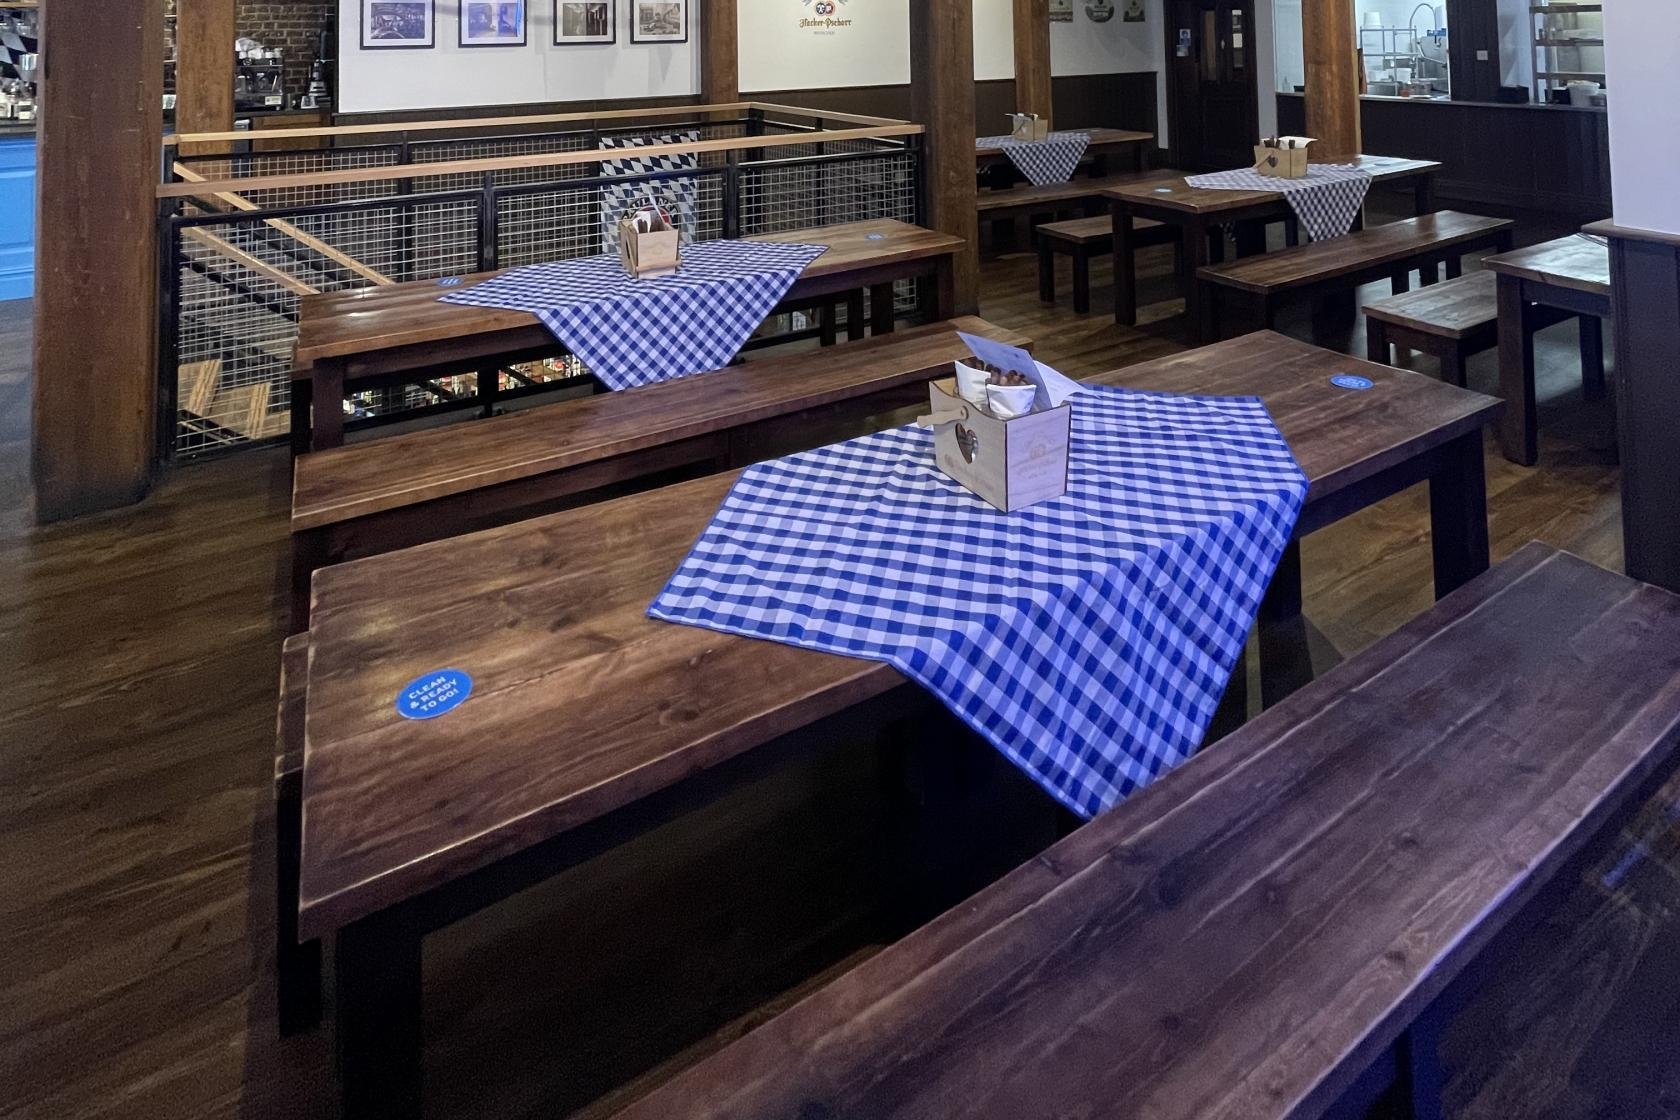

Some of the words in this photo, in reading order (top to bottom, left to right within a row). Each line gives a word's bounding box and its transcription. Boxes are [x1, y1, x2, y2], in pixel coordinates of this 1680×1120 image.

[408, 676, 446, 699] CLEAN
[410, 700, 420, 709] &
[420, 678, 457, 703] READY
[420, 700, 437, 712] TO
